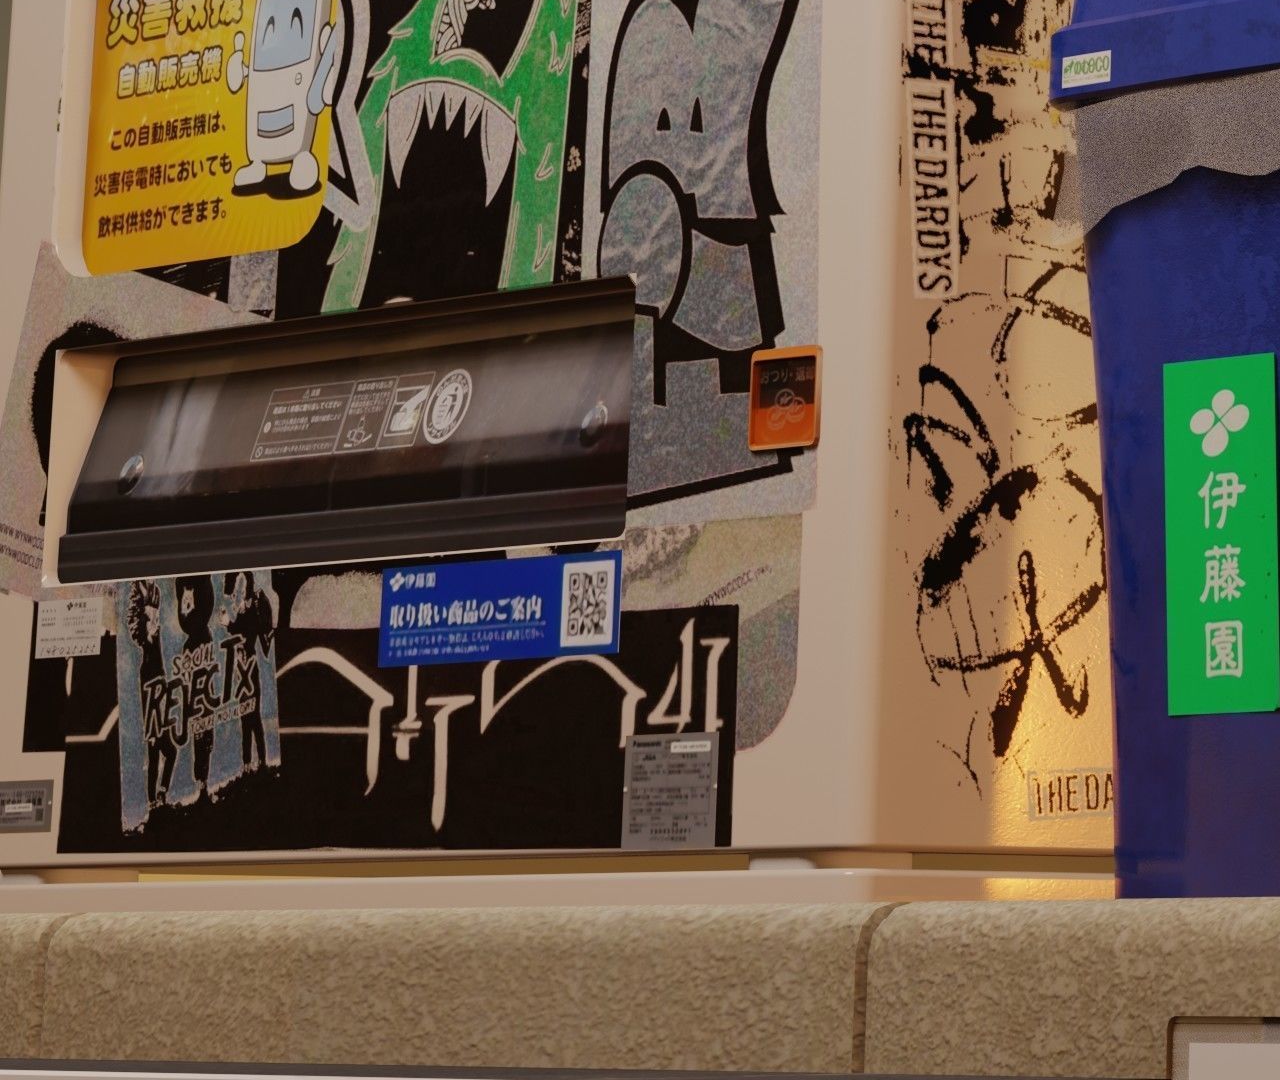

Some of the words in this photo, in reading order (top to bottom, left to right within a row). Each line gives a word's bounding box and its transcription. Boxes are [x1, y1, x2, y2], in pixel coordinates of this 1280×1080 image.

[117, 44, 224, 99] 自動販売機
[110, 110, 227, 151] この自動販売機は、
[93, 152, 233, 197] 災害停電時においても
[97, 196, 227, 240] 飲料供給ができます。
[1197, 470, 1247, 679] 伊藤園
[389, 594, 543, 630] 取り扱い商品のご案内
